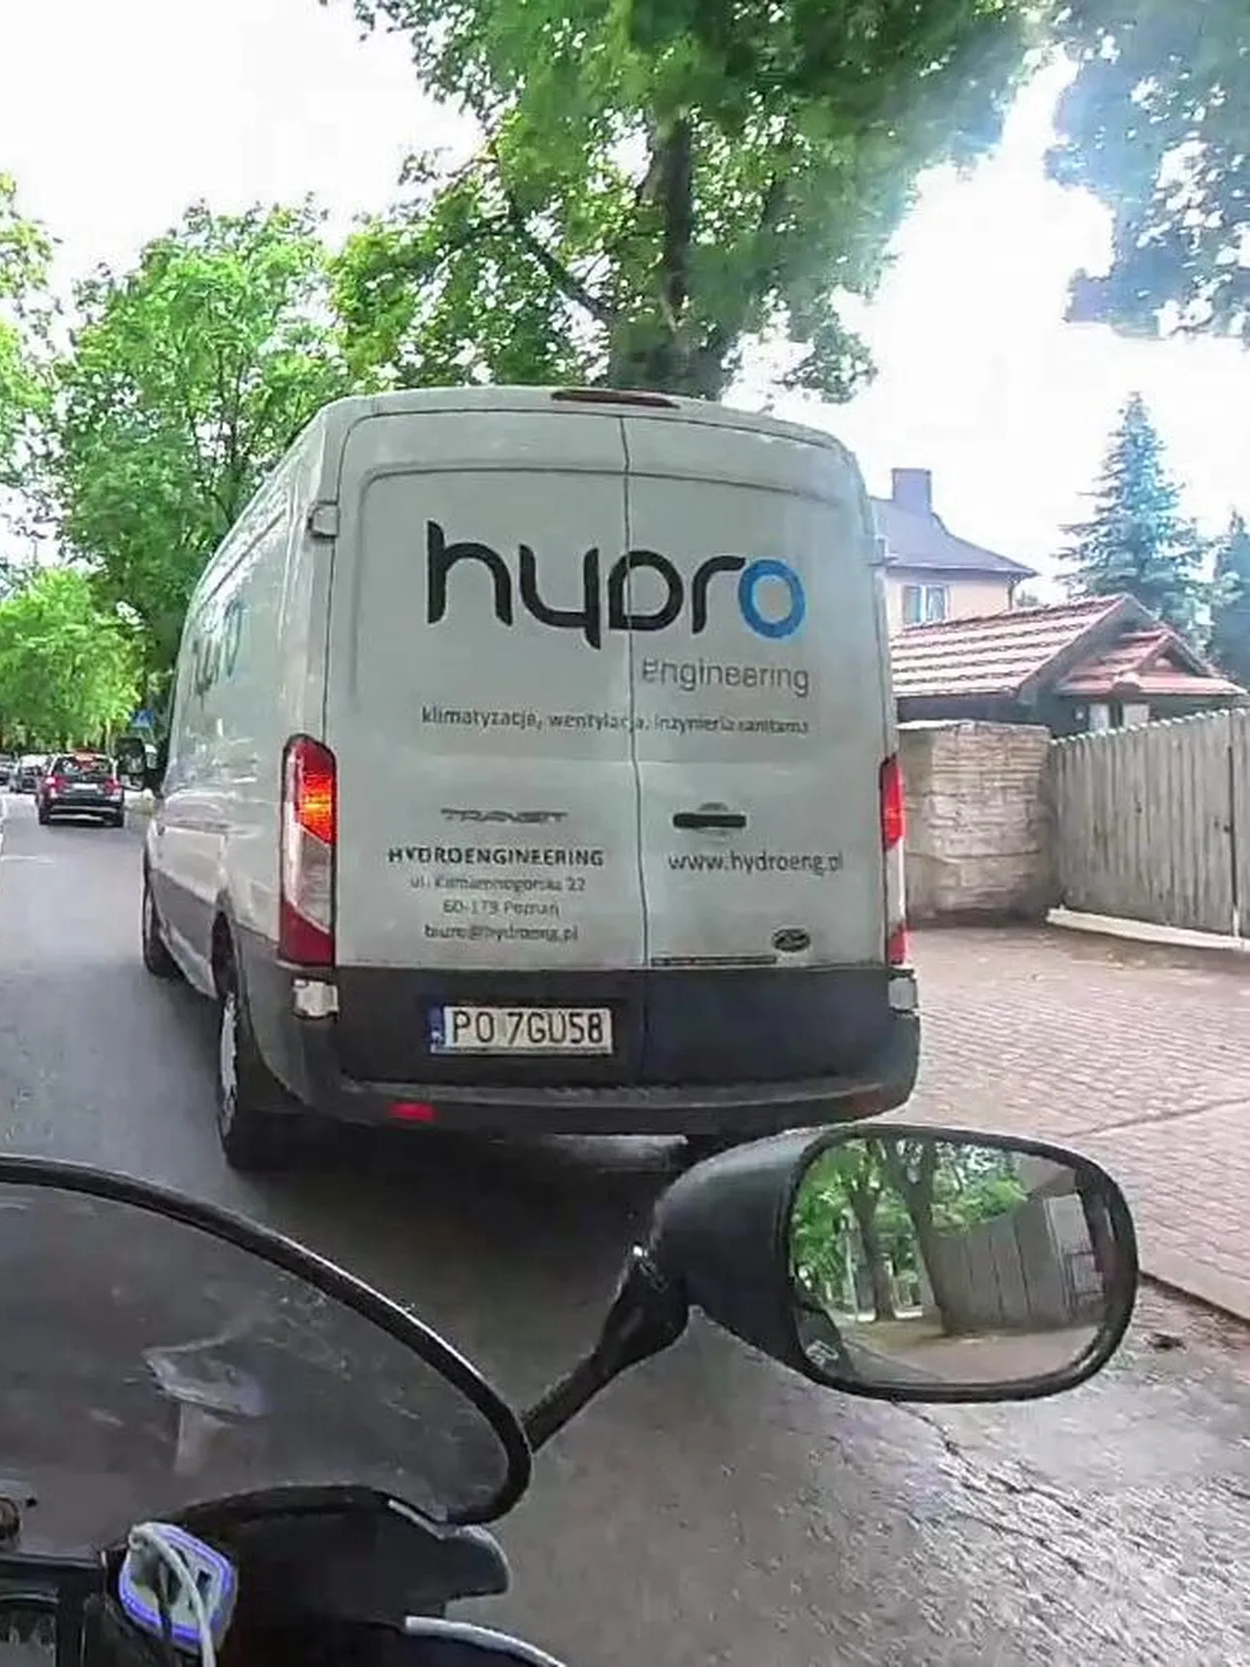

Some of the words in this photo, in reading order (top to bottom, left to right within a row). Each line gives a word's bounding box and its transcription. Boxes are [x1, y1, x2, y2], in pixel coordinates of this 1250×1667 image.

[388, 847, 604, 867] HYDROENGINEERING
[668, 850, 843, 877] www.hydroeng.pl
[453, 1010, 495, 1044] PO
[506, 1011, 604, 1044] 7GU58
